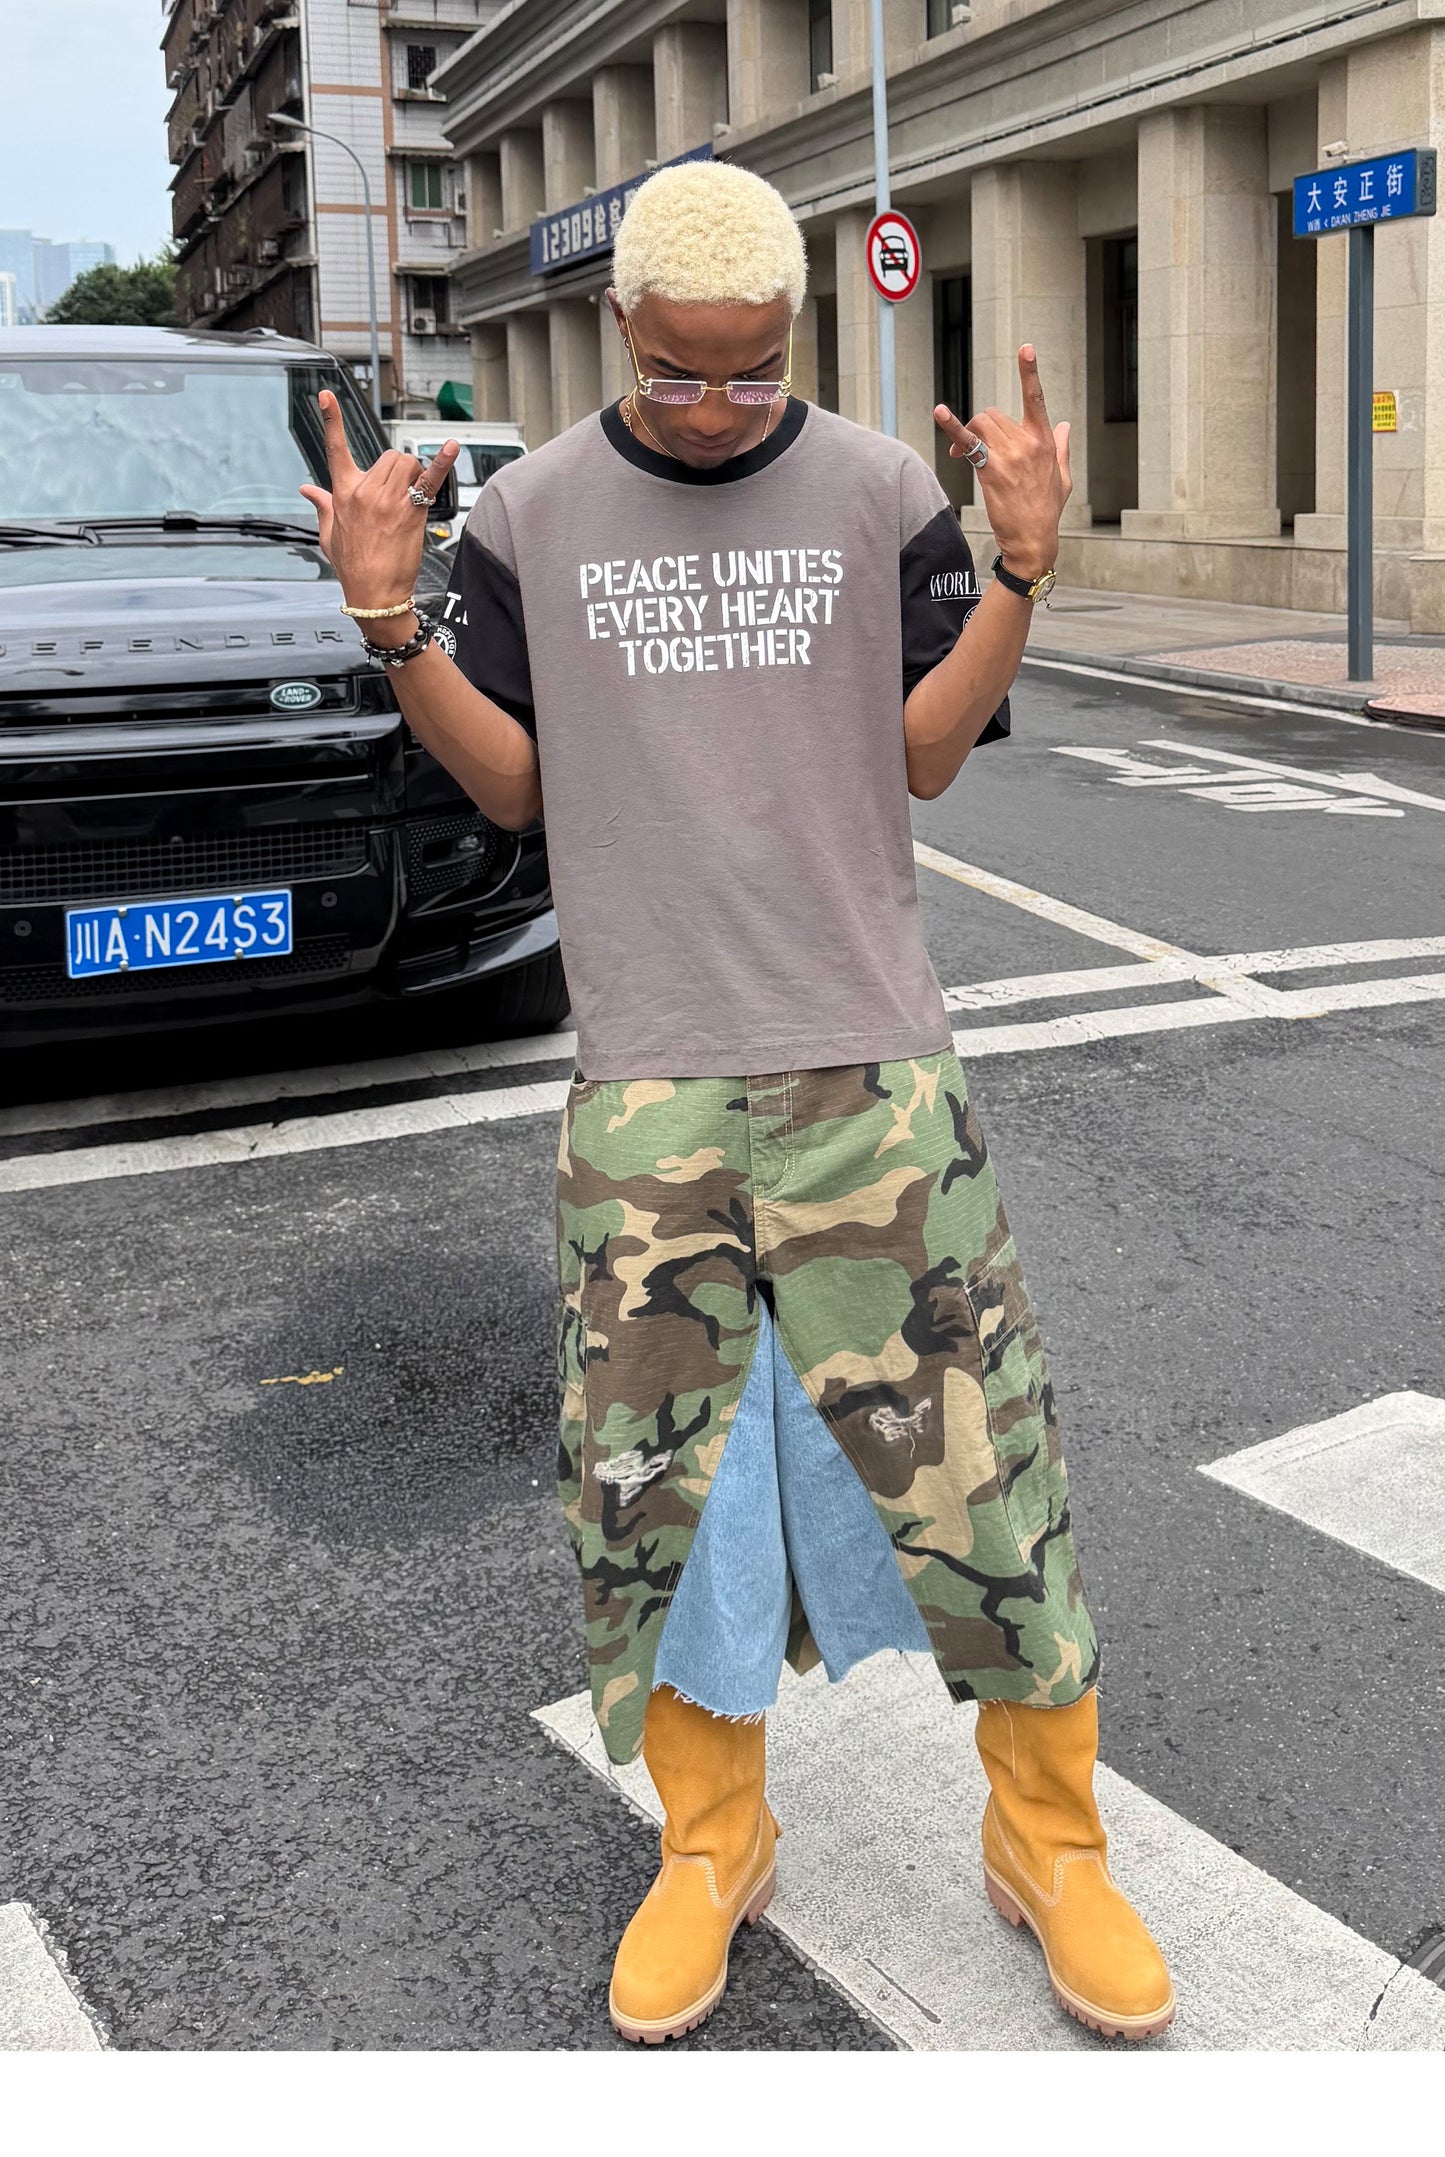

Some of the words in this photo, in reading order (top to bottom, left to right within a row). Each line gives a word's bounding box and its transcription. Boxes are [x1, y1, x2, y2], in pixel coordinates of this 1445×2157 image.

[1307, 164, 1403, 213] 大安正街
[1353, 207, 1377, 223] ZHENG
[1380, 204, 1392, 217] JIE
[579, 555, 702, 599] PEACE
[712, 549, 844, 587] UNITES
[587, 595, 709, 640] EVERY
[721, 588, 840, 628] HEART
[0, 629, 343, 657] EFENDER
[618, 629, 811, 676] TOGETHER
[281, 688, 305, 697] LAND
[284, 694, 312, 703] ROVER
